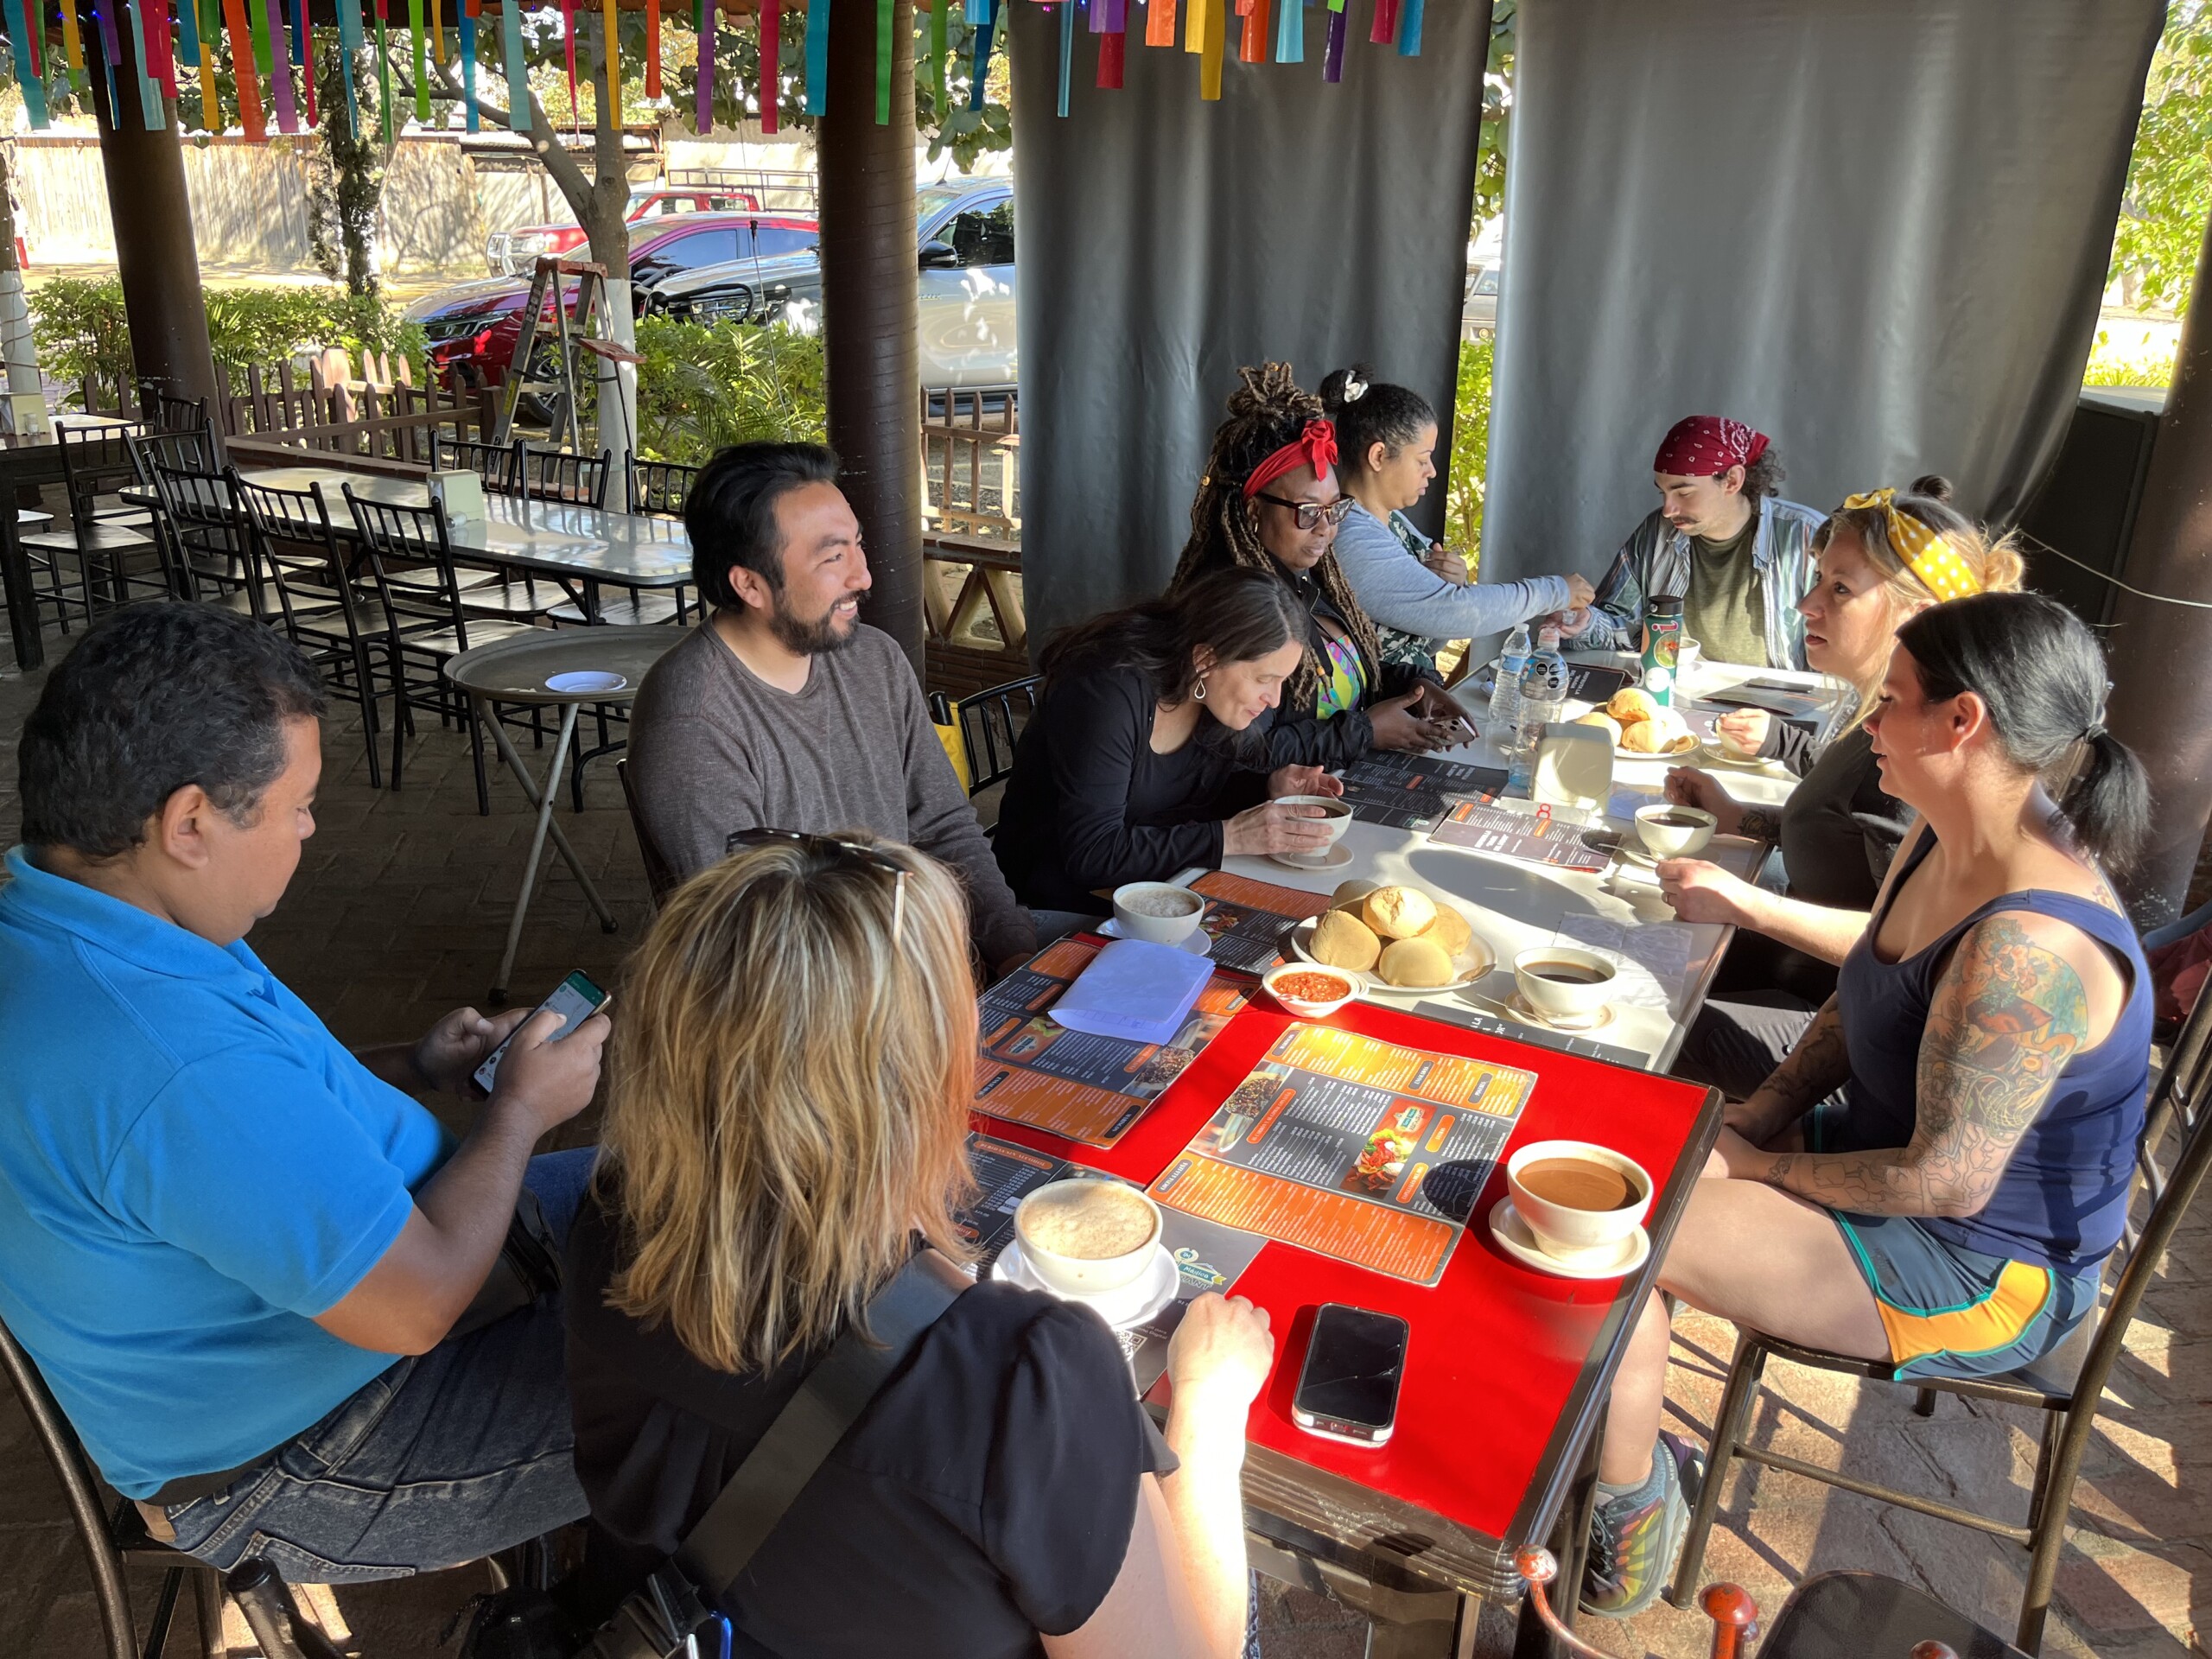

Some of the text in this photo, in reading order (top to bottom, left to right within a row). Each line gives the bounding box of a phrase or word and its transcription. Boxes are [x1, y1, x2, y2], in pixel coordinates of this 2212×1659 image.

[1536, 804, 1551, 819] 8
[1471, 1014, 1483, 1026] LA
[1183, 1264, 1209, 1279] Mágica
[1148, 1330, 1167, 1341] Digital
